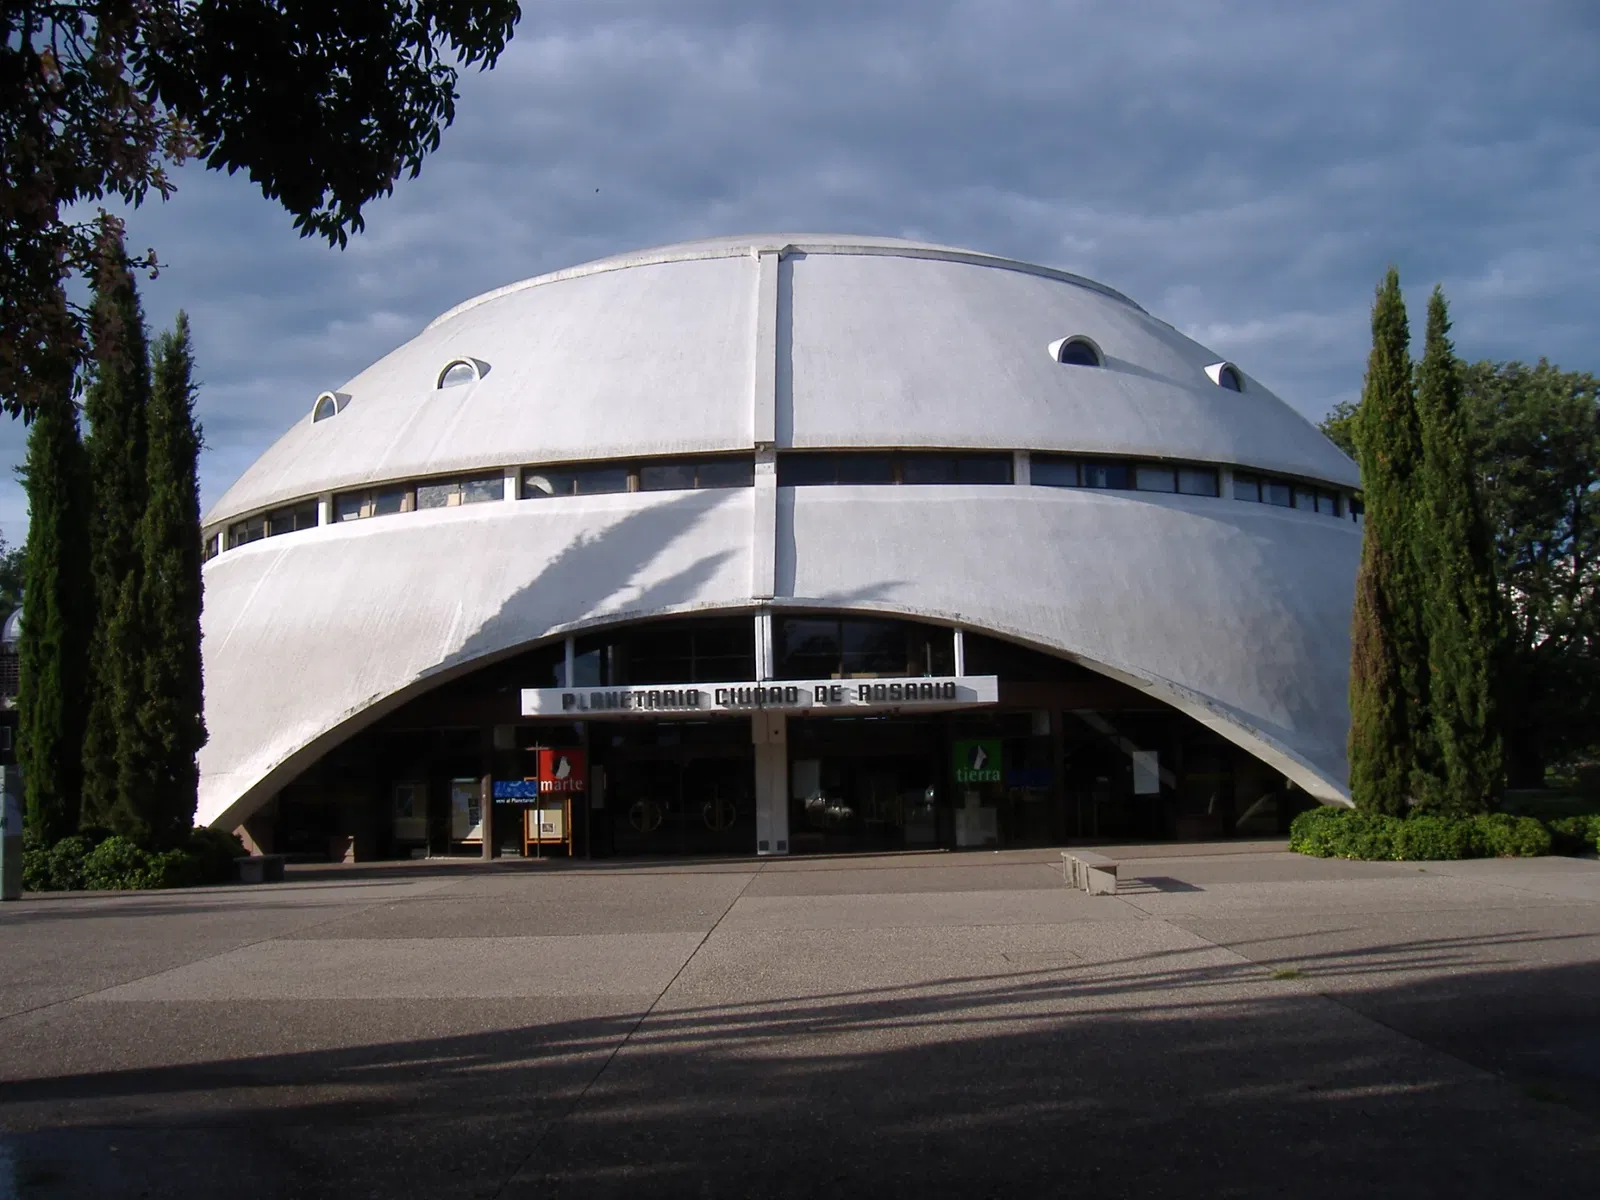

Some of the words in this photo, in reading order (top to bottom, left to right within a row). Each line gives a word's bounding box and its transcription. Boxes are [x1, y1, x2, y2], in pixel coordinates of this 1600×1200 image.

[562, 689, 700, 711] PLANETARIO
[715, 686, 799, 707] CIUDAD
[815, 685, 842, 703] DE
[858, 682, 956, 702] ROSARIO
[956, 765, 1000, 782] tierra
[540, 777, 584, 791] marte
